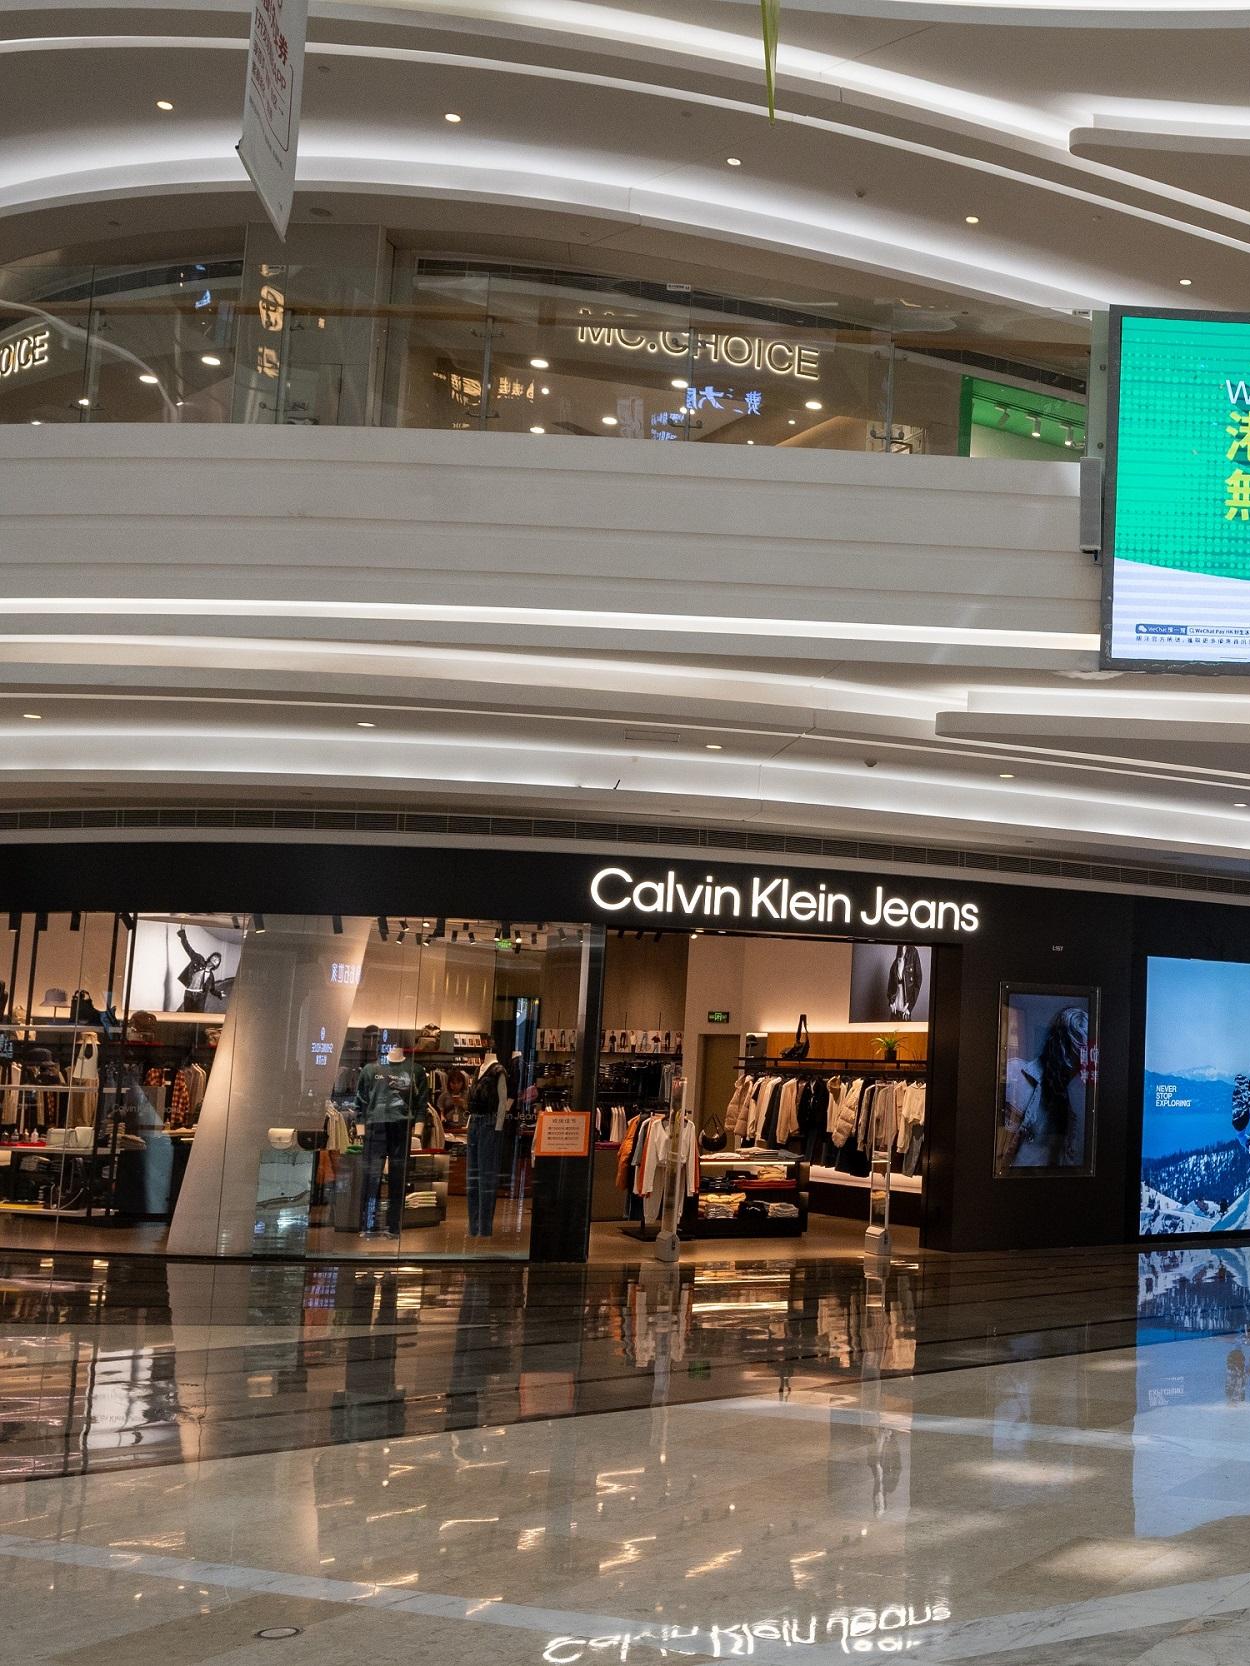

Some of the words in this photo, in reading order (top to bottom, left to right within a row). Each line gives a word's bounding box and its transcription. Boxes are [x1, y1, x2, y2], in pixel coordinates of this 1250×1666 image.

[590, 867, 743, 918] Calvin
[750, 877, 853, 924] Klein
[860, 886, 980, 933] Jeans
[1155, 1085, 1177, 1093] NEVER
[1155, 1092, 1173, 1100] STOP
[1155, 1099, 1192, 1107] EXPLORING
